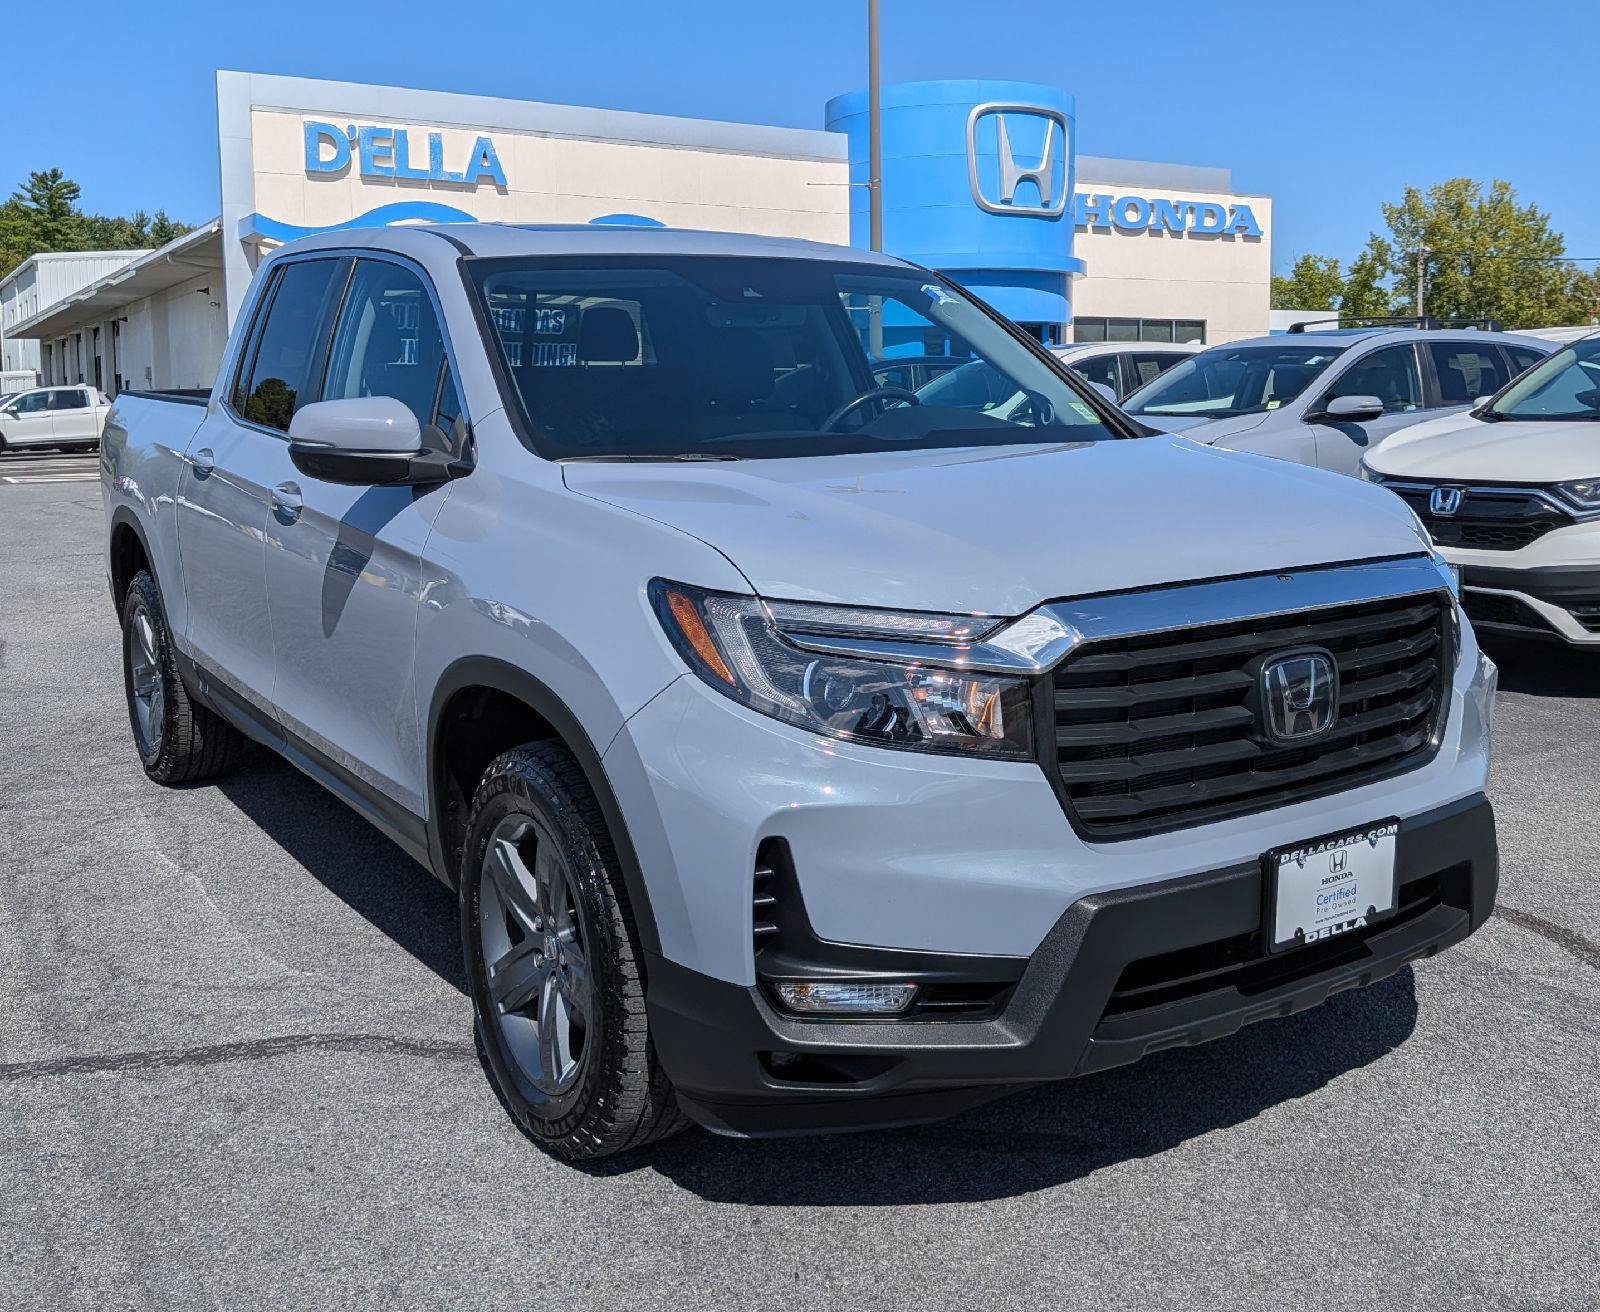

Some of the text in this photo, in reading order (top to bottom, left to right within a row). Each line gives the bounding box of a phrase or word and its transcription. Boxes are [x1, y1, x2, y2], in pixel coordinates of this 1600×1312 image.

[303, 120, 507, 186] D'ELLA
[1074, 192, 1264, 238] HONDA
[1280, 824, 1398, 863] DELLACARS.COM
[1316, 883, 1357, 906] Certified
[1321, 871, 1353, 885] HONDA
[1304, 917, 1368, 944] DELLA
